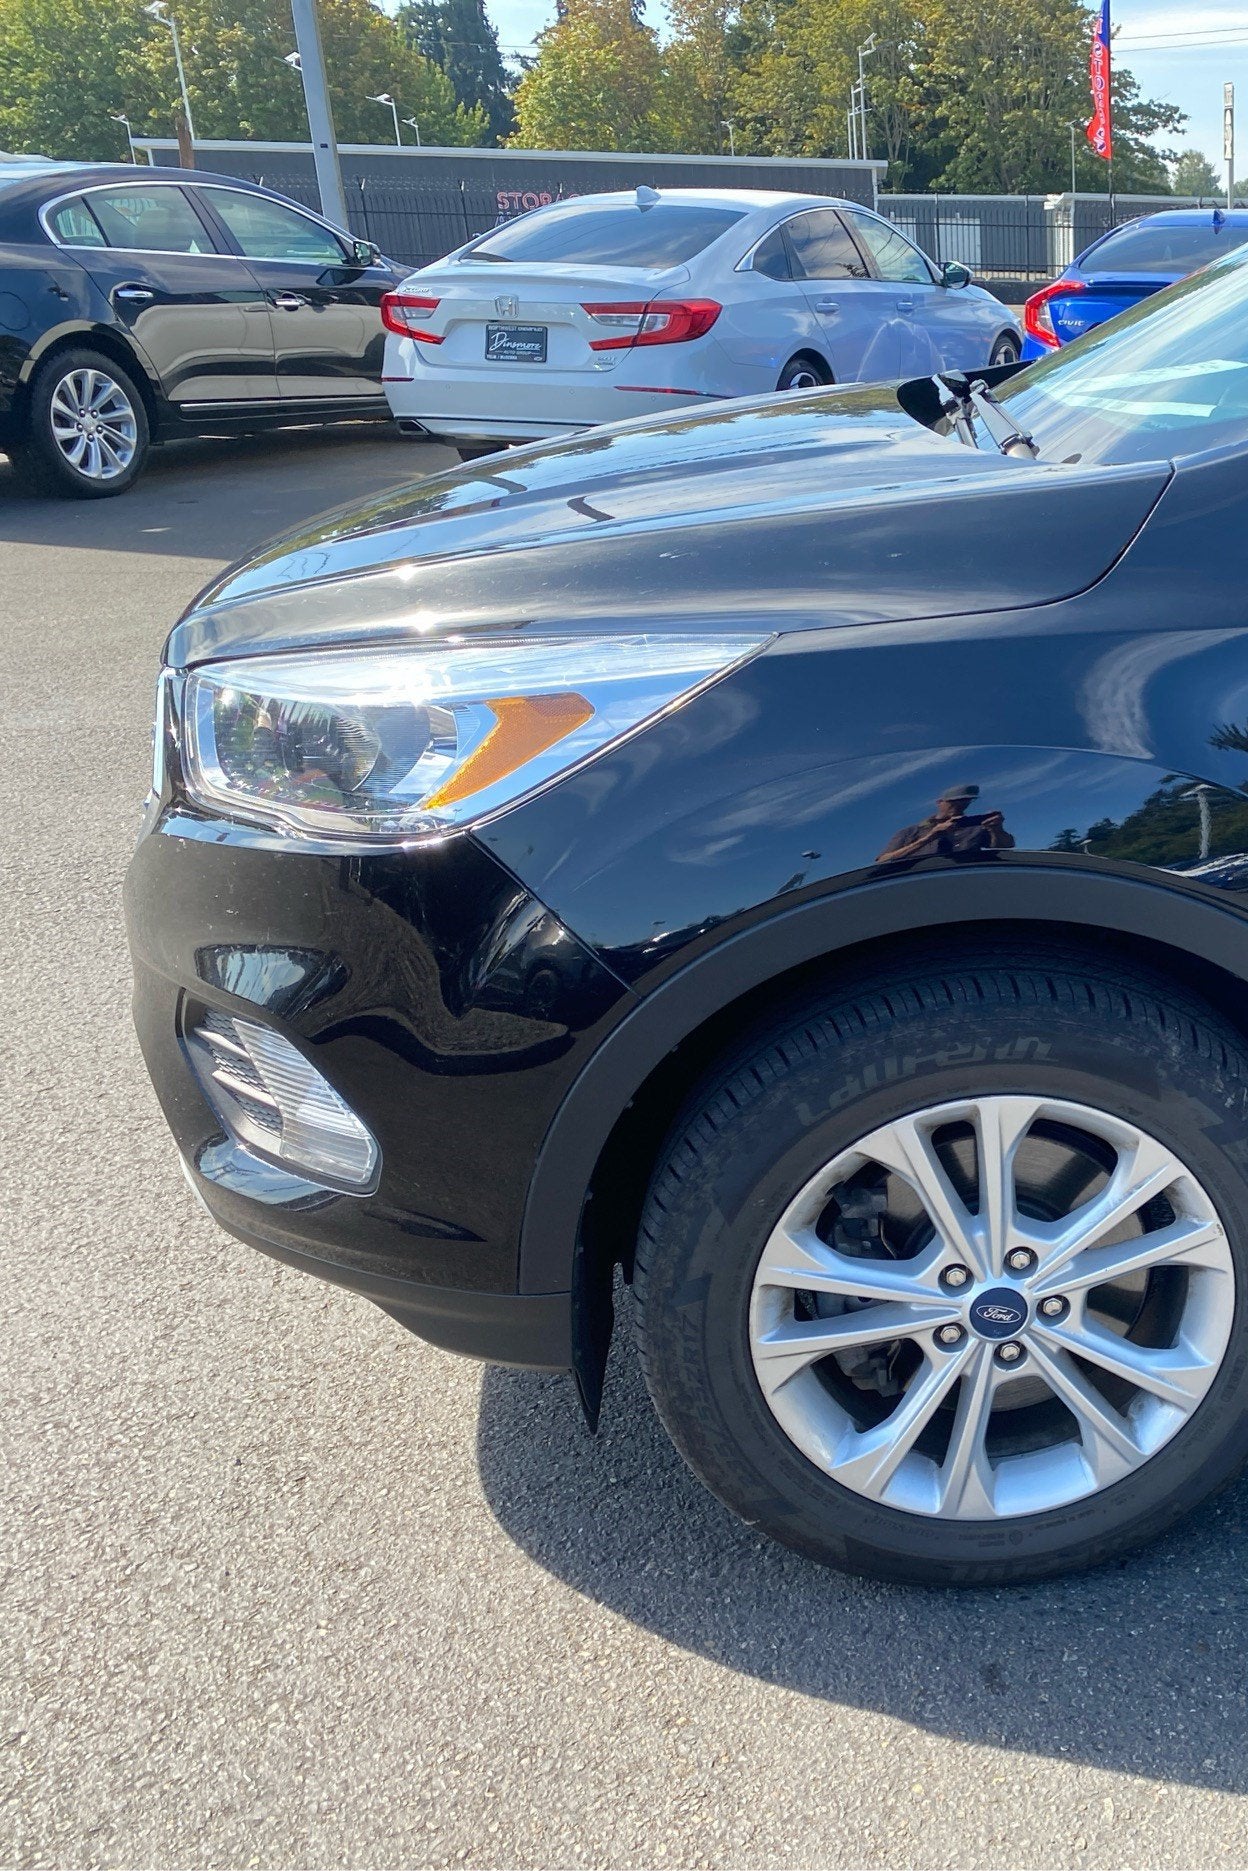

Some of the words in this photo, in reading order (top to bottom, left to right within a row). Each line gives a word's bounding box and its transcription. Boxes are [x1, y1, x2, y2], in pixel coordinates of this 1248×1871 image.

[496, 191, 579, 210] STOR
[1058, 319, 1085, 327] CIVIC
[983, 1307, 1014, 1321] Ford
